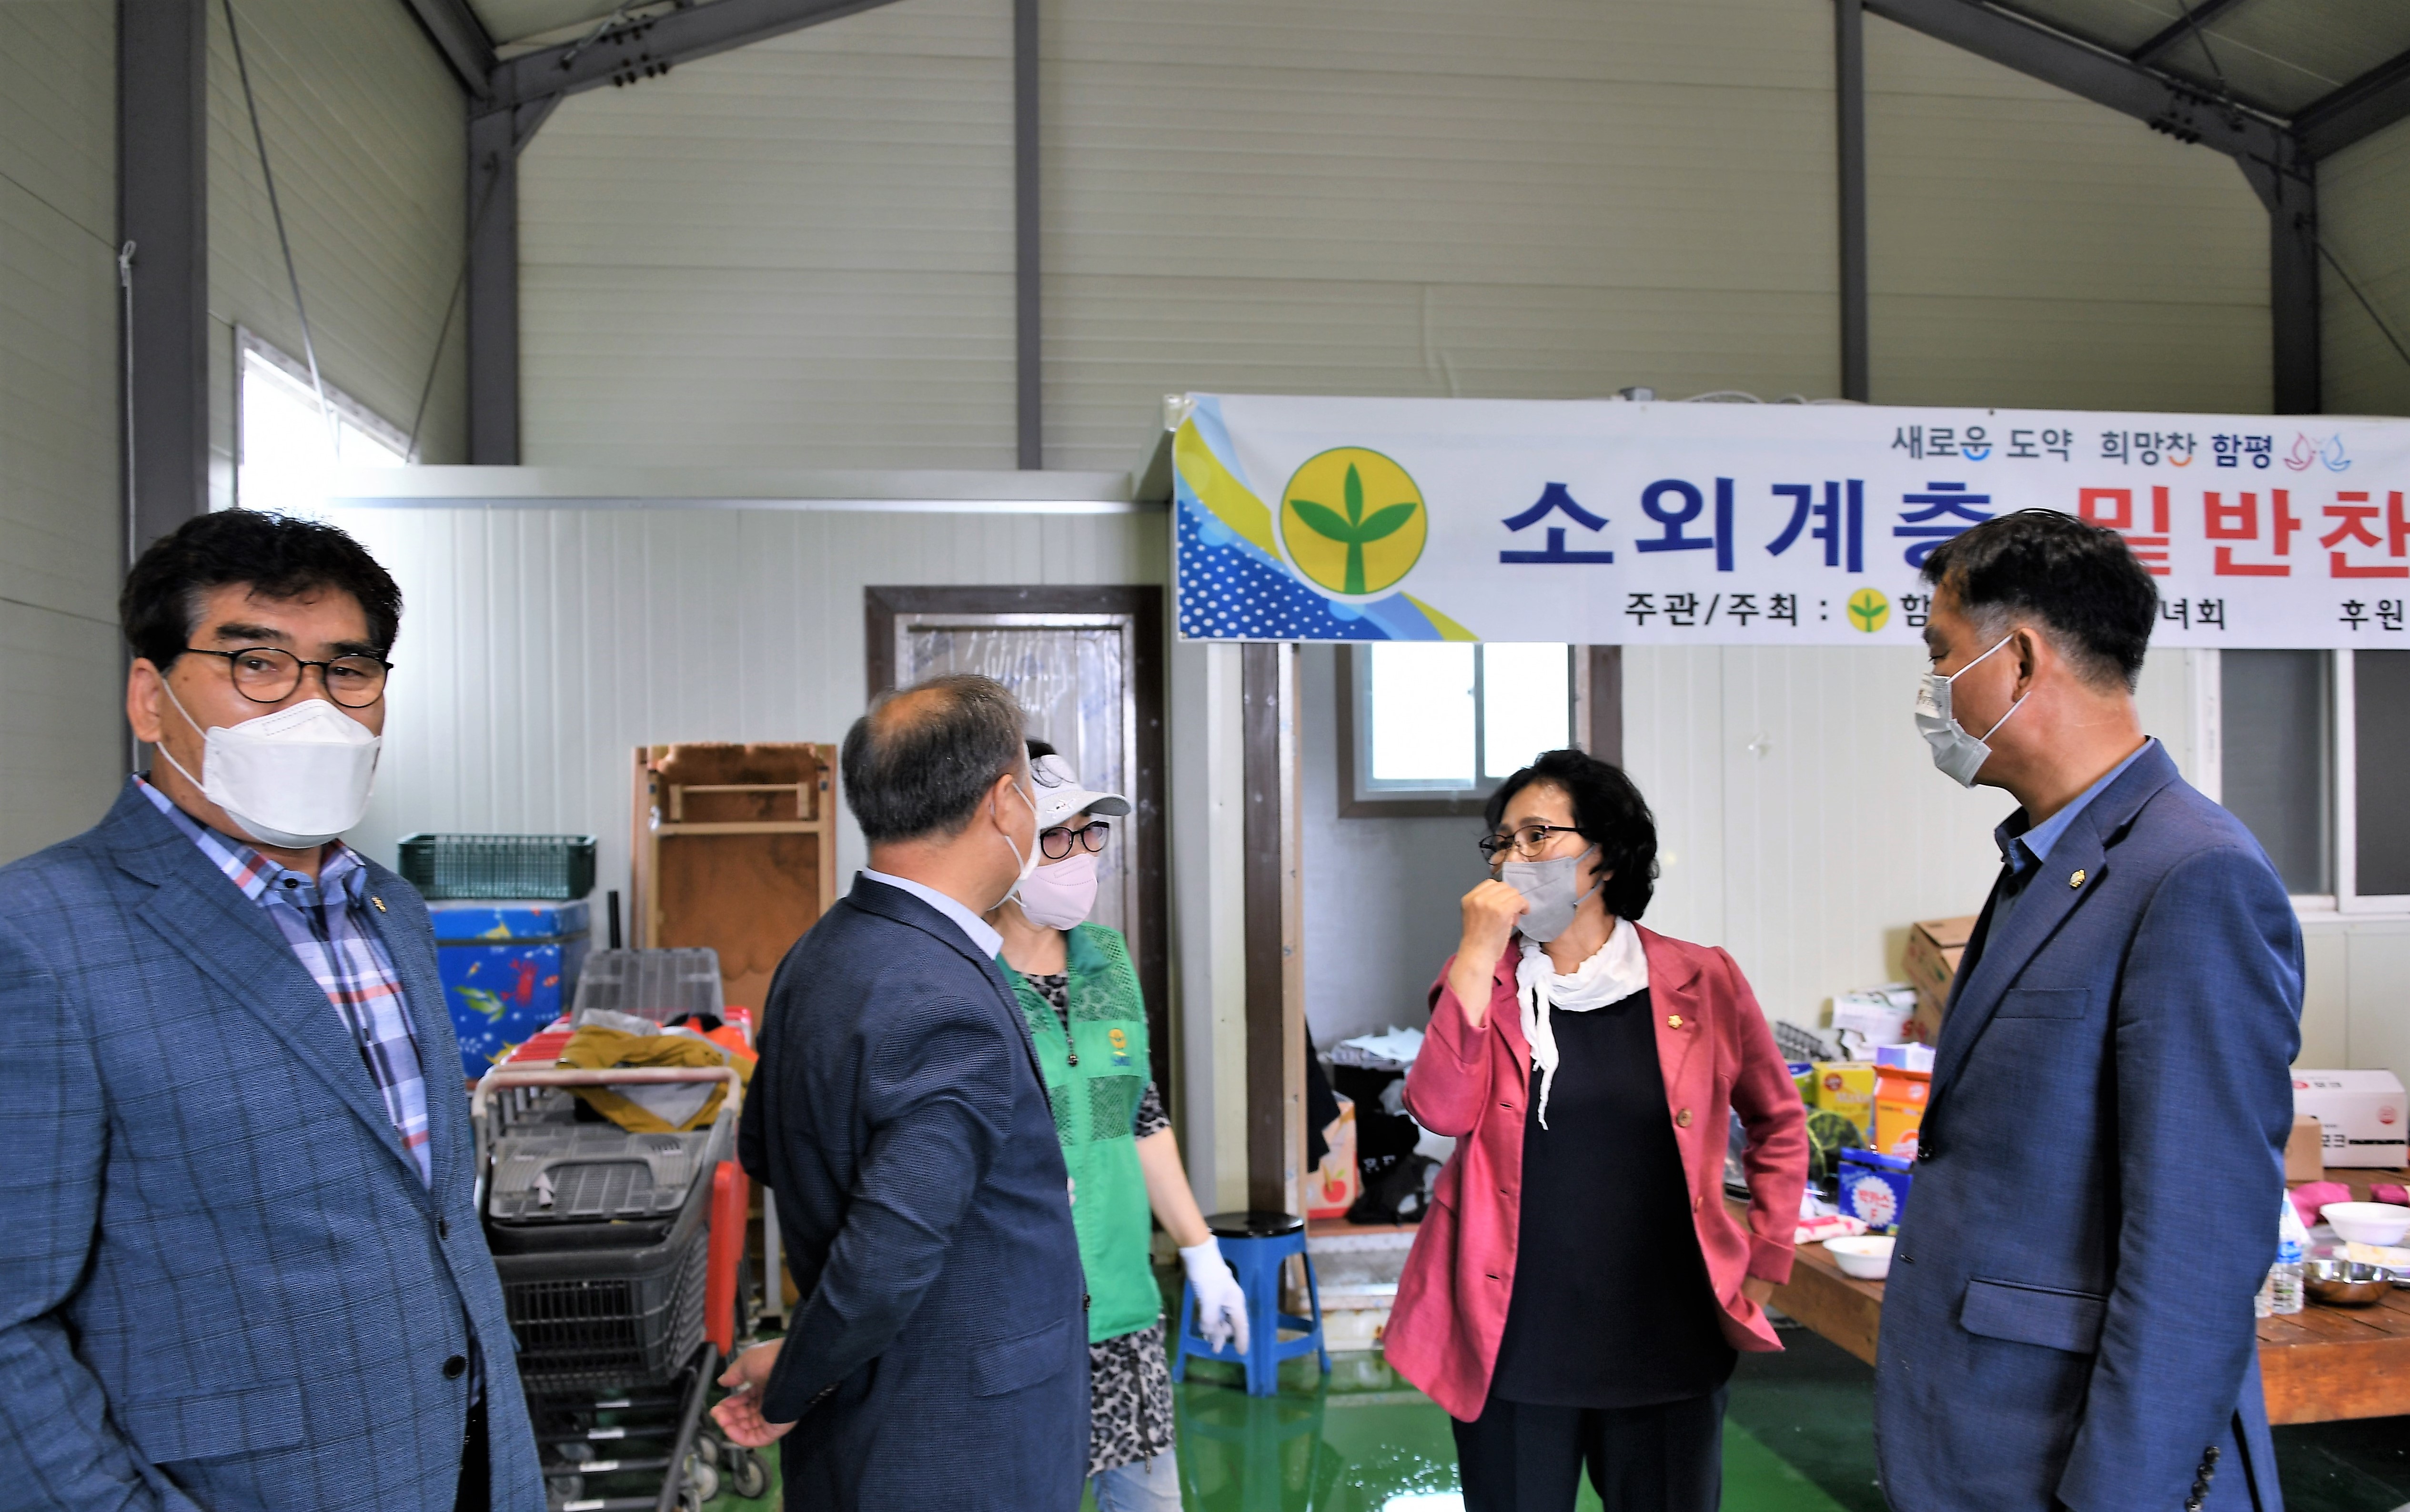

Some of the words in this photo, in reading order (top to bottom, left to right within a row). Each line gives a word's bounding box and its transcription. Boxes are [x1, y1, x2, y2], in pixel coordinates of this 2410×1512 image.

[1892, 426, 1993, 461] 새로운
[2007, 429, 2073, 462] 도약
[2101, 431, 2197, 467] 희망찬
[2212, 433, 2272, 469] 함평
[1500, 477, 1996, 572] 소외계층
[2079, 485, 2410, 578] 밑반찬
[1625, 593, 1797, 626] 주관/주최
[2339, 599, 2404, 631] 후원
